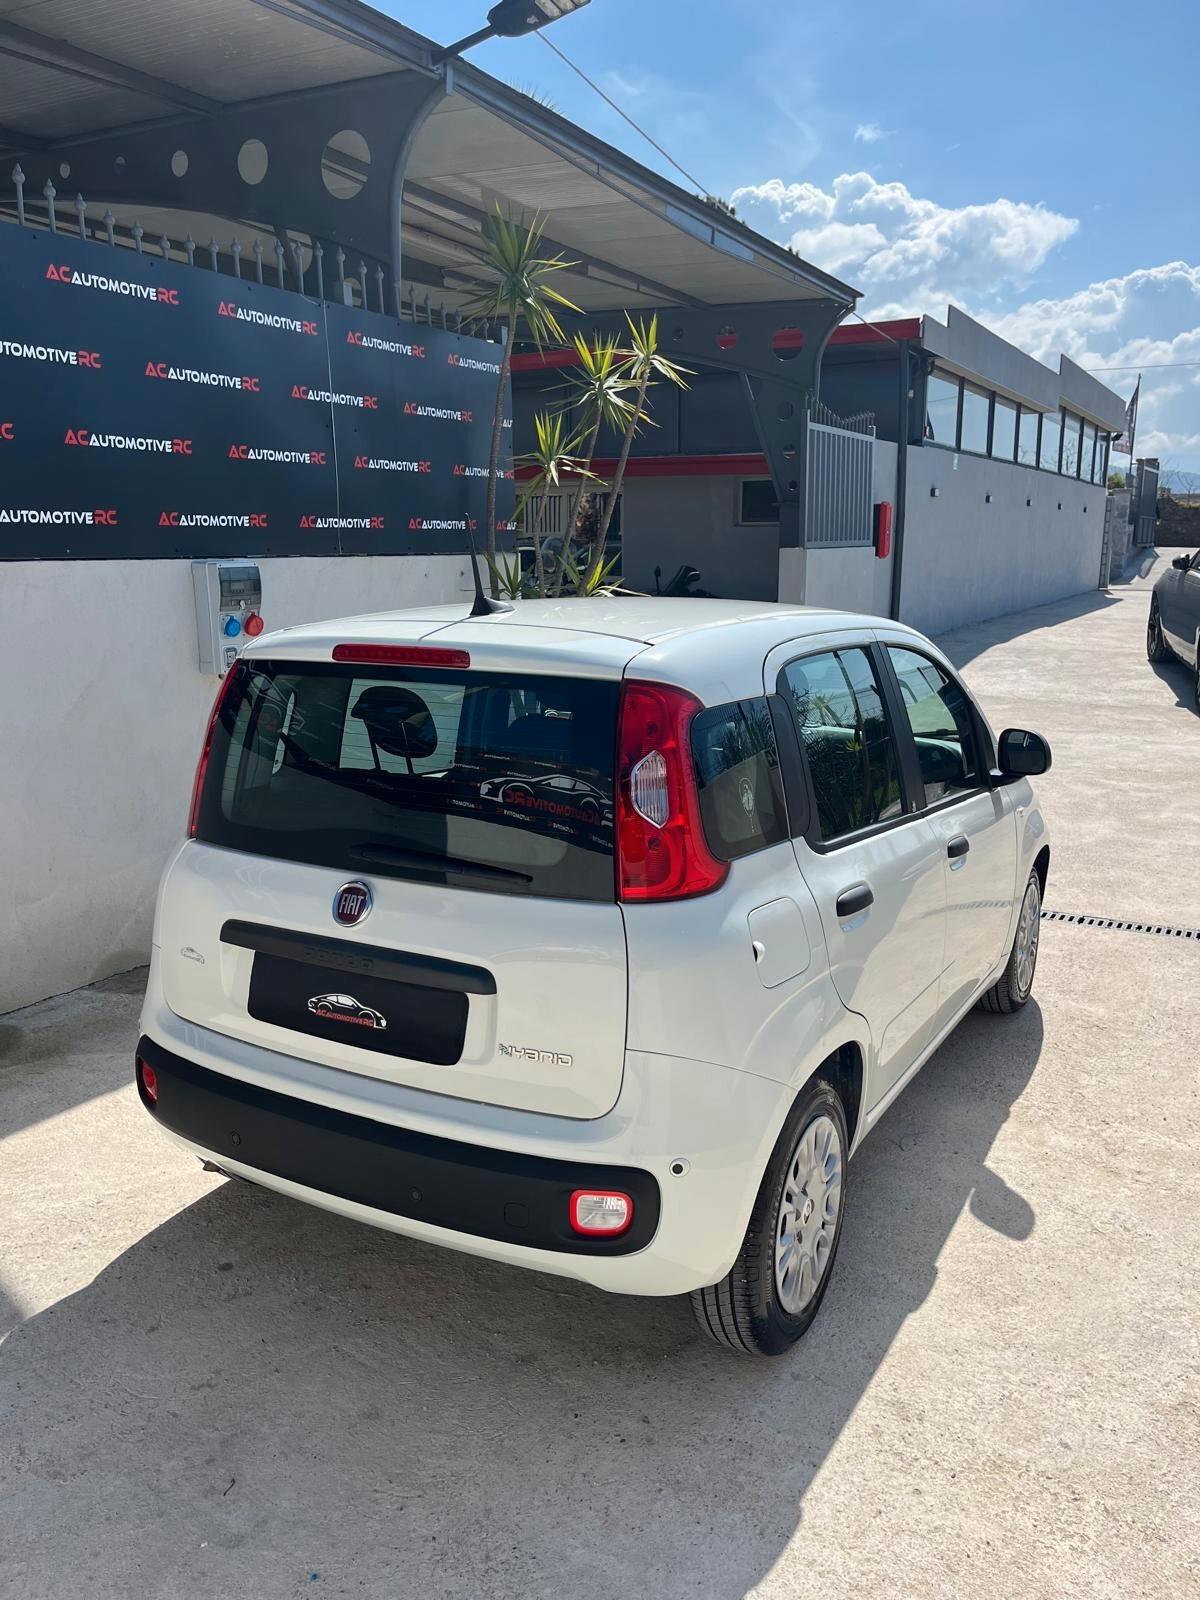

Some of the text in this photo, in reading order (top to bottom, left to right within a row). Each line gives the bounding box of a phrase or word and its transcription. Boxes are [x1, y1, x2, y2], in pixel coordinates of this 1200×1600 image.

[46, 263, 179, 305] ACAUTOMOTIVERC
[218, 301, 318, 335] ACAUTOMOTIVERC
[347, 330, 425, 358] ACAUTOMOTIVERC
[145, 362, 260, 392] ACAUTOMOTIVERC
[291, 385, 378, 410] ACAUTOMOTIVERC
[64, 428, 192, 454] ACAUTOMOTIVERC
[228, 444, 326, 465] ACAUTOMOTIVERC
[354, 456, 431, 473] ACAUTOMOTIVERC
[158, 512, 268, 528] ACAUTOMOTIVERC
[339, 893, 365, 915] FIAT
[499, 1043, 573, 1066] HYBRID
